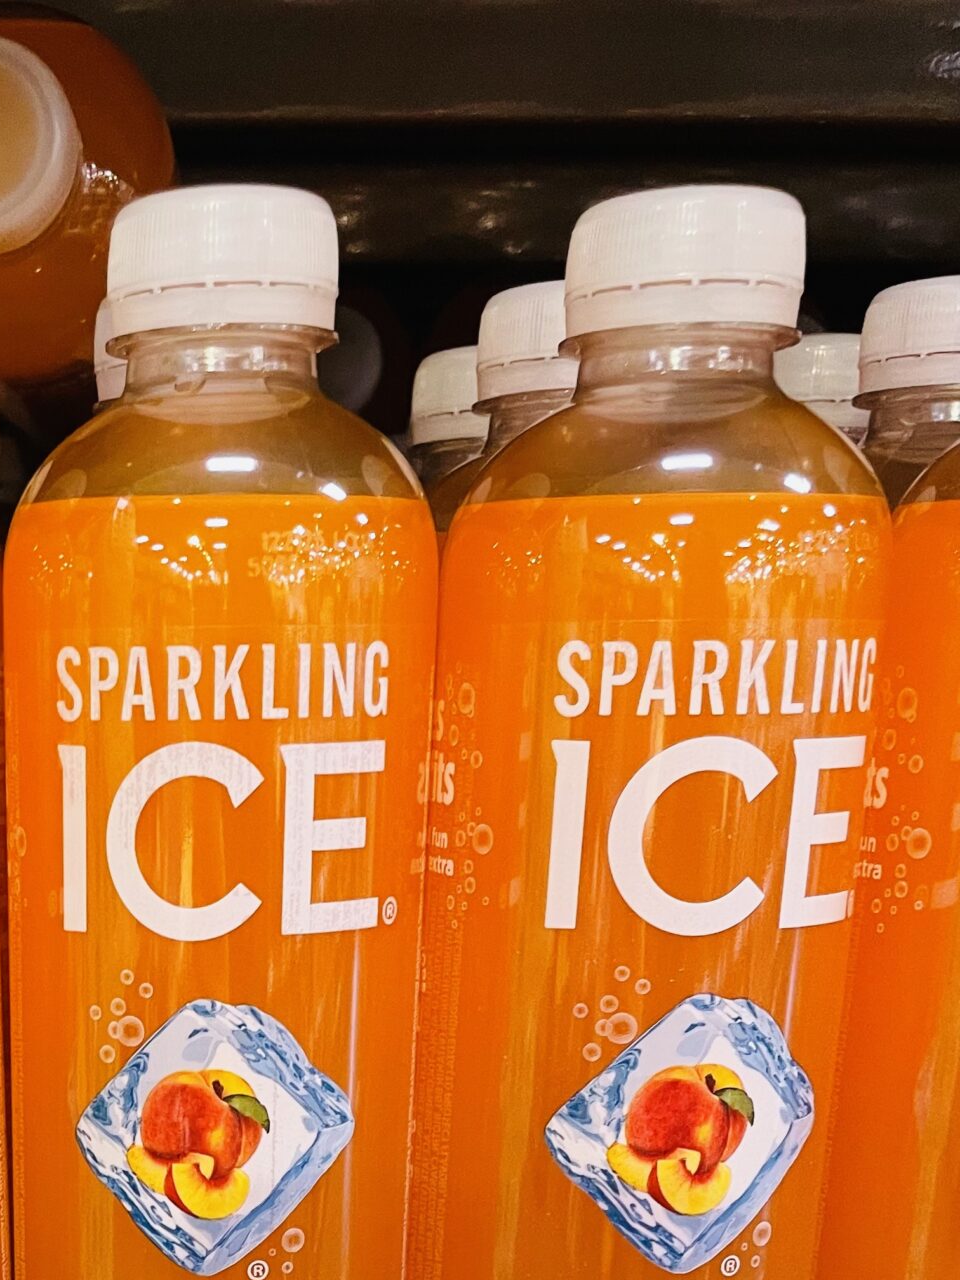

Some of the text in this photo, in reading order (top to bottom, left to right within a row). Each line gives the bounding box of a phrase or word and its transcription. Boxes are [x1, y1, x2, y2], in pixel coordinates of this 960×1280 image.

[56, 640, 390, 723] SPARKLING
[553, 637, 878, 718] SPARKLING
[57, 740, 386, 942] ICE
[544, 735, 867, 936] ICE
